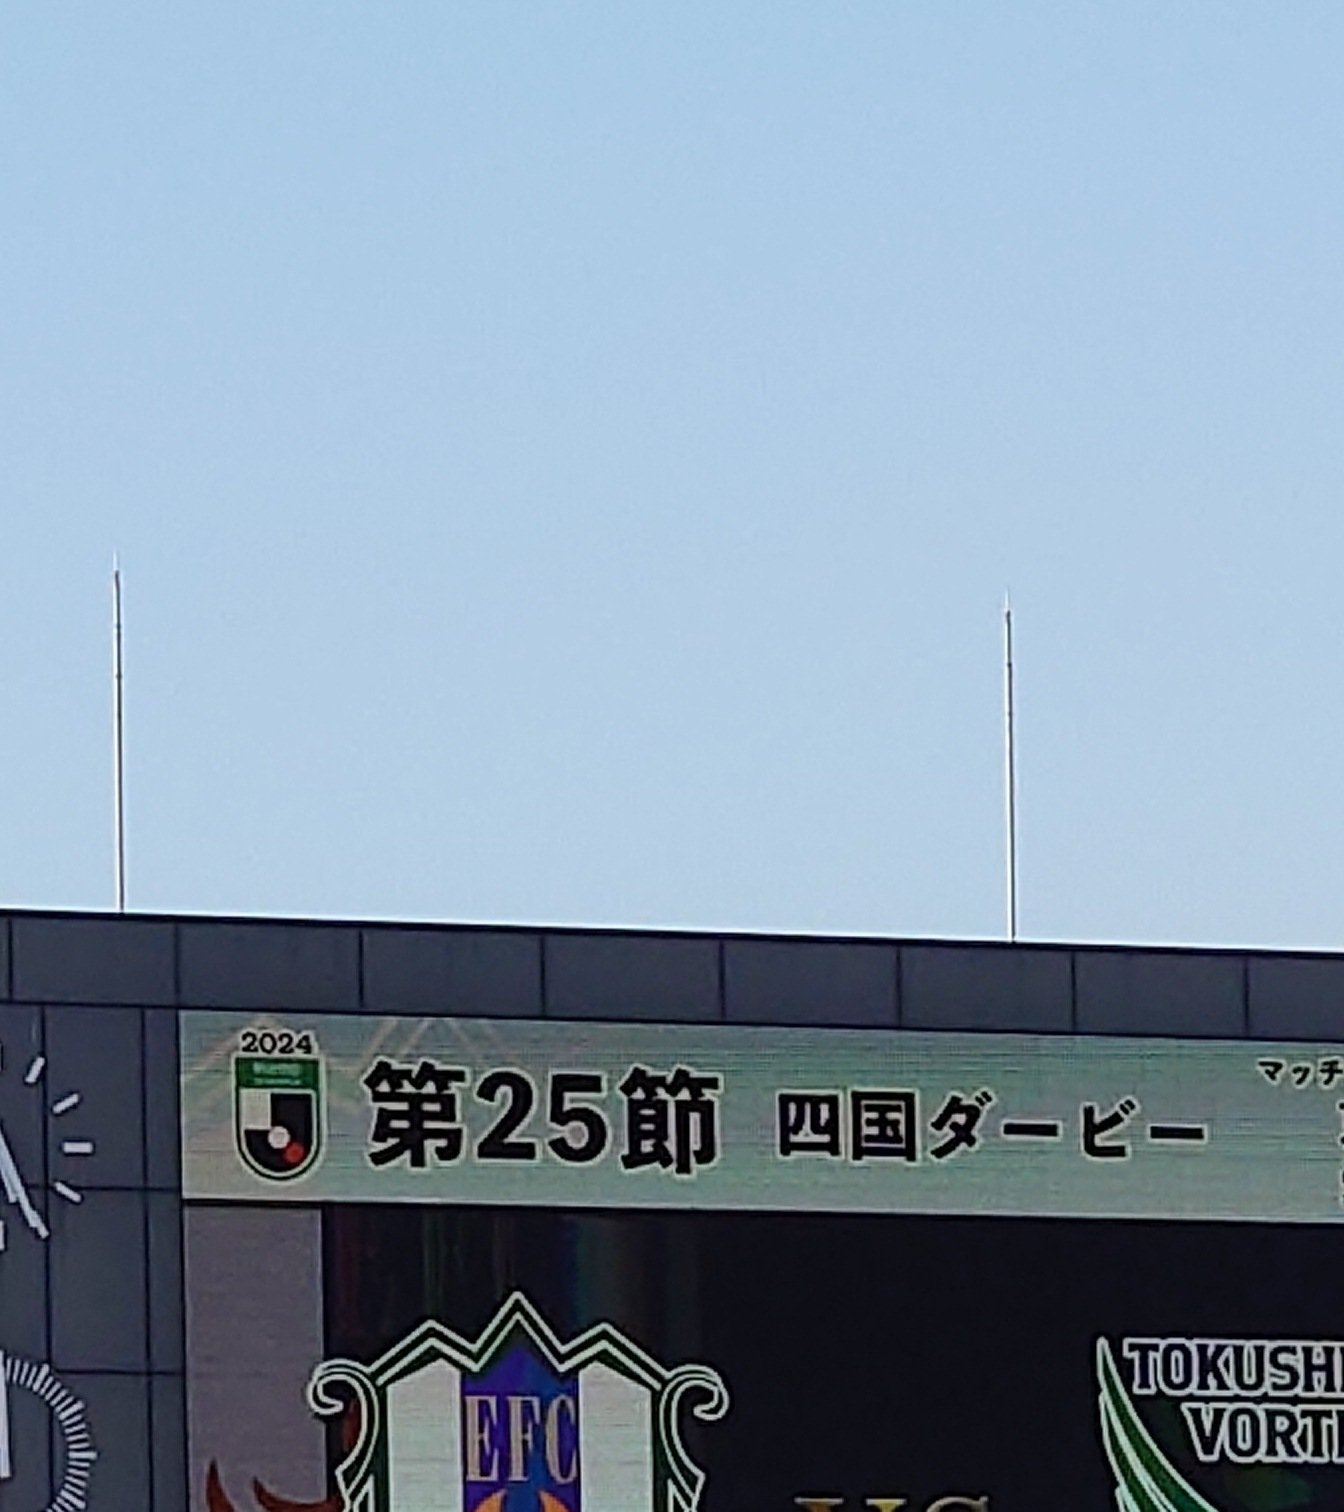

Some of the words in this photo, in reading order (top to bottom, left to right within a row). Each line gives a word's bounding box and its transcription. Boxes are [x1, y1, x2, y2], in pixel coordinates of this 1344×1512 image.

[241, 1031, 313, 1054] 2024
[363, 1061, 719, 1174] 第25節
[778, 1090, 1205, 1162] 四国ダービー
[464, 1394, 578, 1484] EFC
